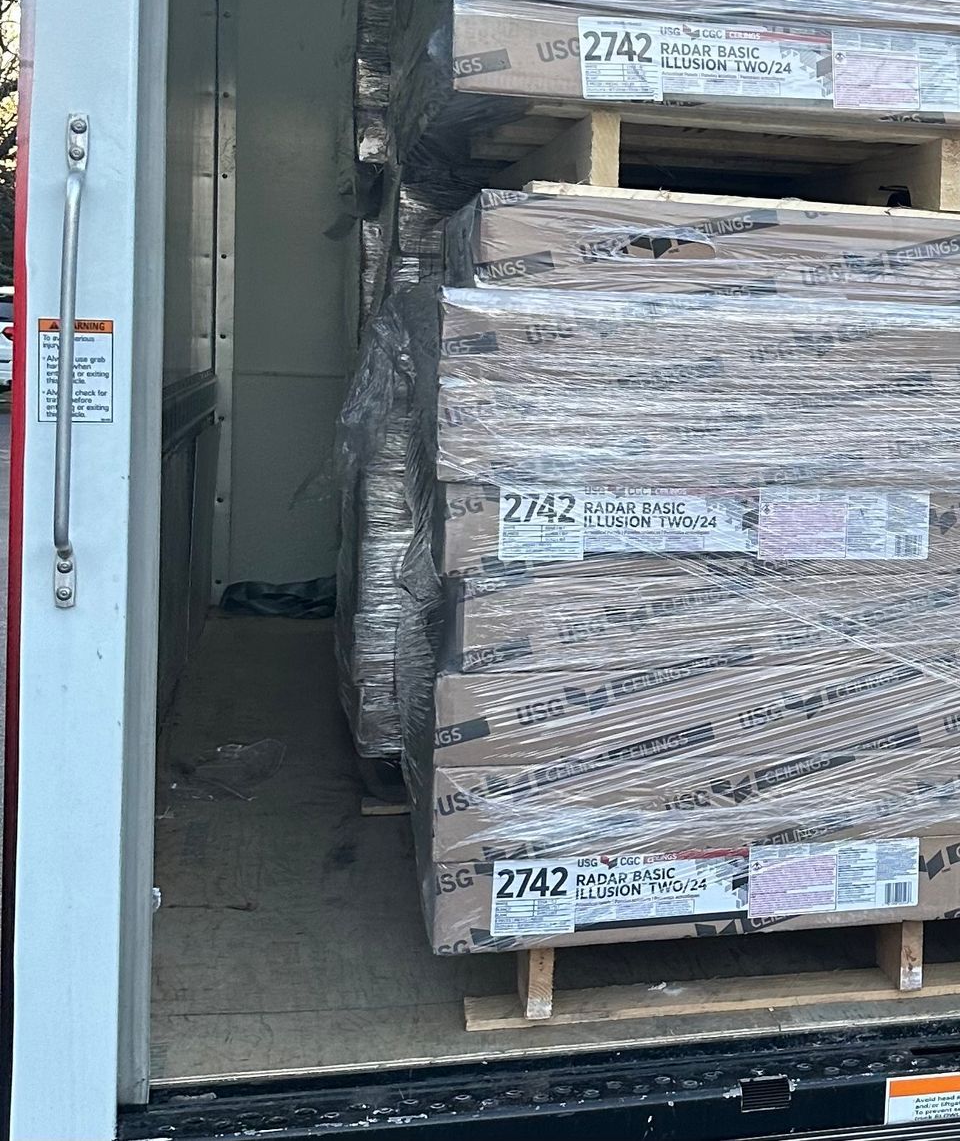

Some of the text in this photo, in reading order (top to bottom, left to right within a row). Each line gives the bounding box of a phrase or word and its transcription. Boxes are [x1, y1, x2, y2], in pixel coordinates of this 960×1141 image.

[660, 26, 761, 40] USG CGC CEILINGS
[536, 37, 579, 63] USG
[583, 31, 653, 63] 2742
[660, 42, 760, 59] RADAR BASIC
[661, 56, 792, 75] ILLUSION TWO/24
[698, 214, 755, 237] EILINGS
[896, 238, 960, 261] CEILINGS
[73, 322, 105, 330] ARNING
[448, 496, 484, 519] SG
[503, 492, 576, 523] 2742
[584, 501, 686, 515] RADAR BASIC
[583, 515, 717, 529] ILLUSION TWO/24
[621, 667, 691, 693] CEILINGS
[516, 698, 566, 726] USG
[619, 732, 689, 759] CEILINGS
[763, 759, 832, 785] CEILINGS
[577, 858, 598, 868] USG
[620, 856, 641, 866] CGC
[496, 867, 568, 899] 2742
[575, 878, 707, 900] ILLUSION TWO/24
[576, 868, 676, 887] RADAR BASIC
